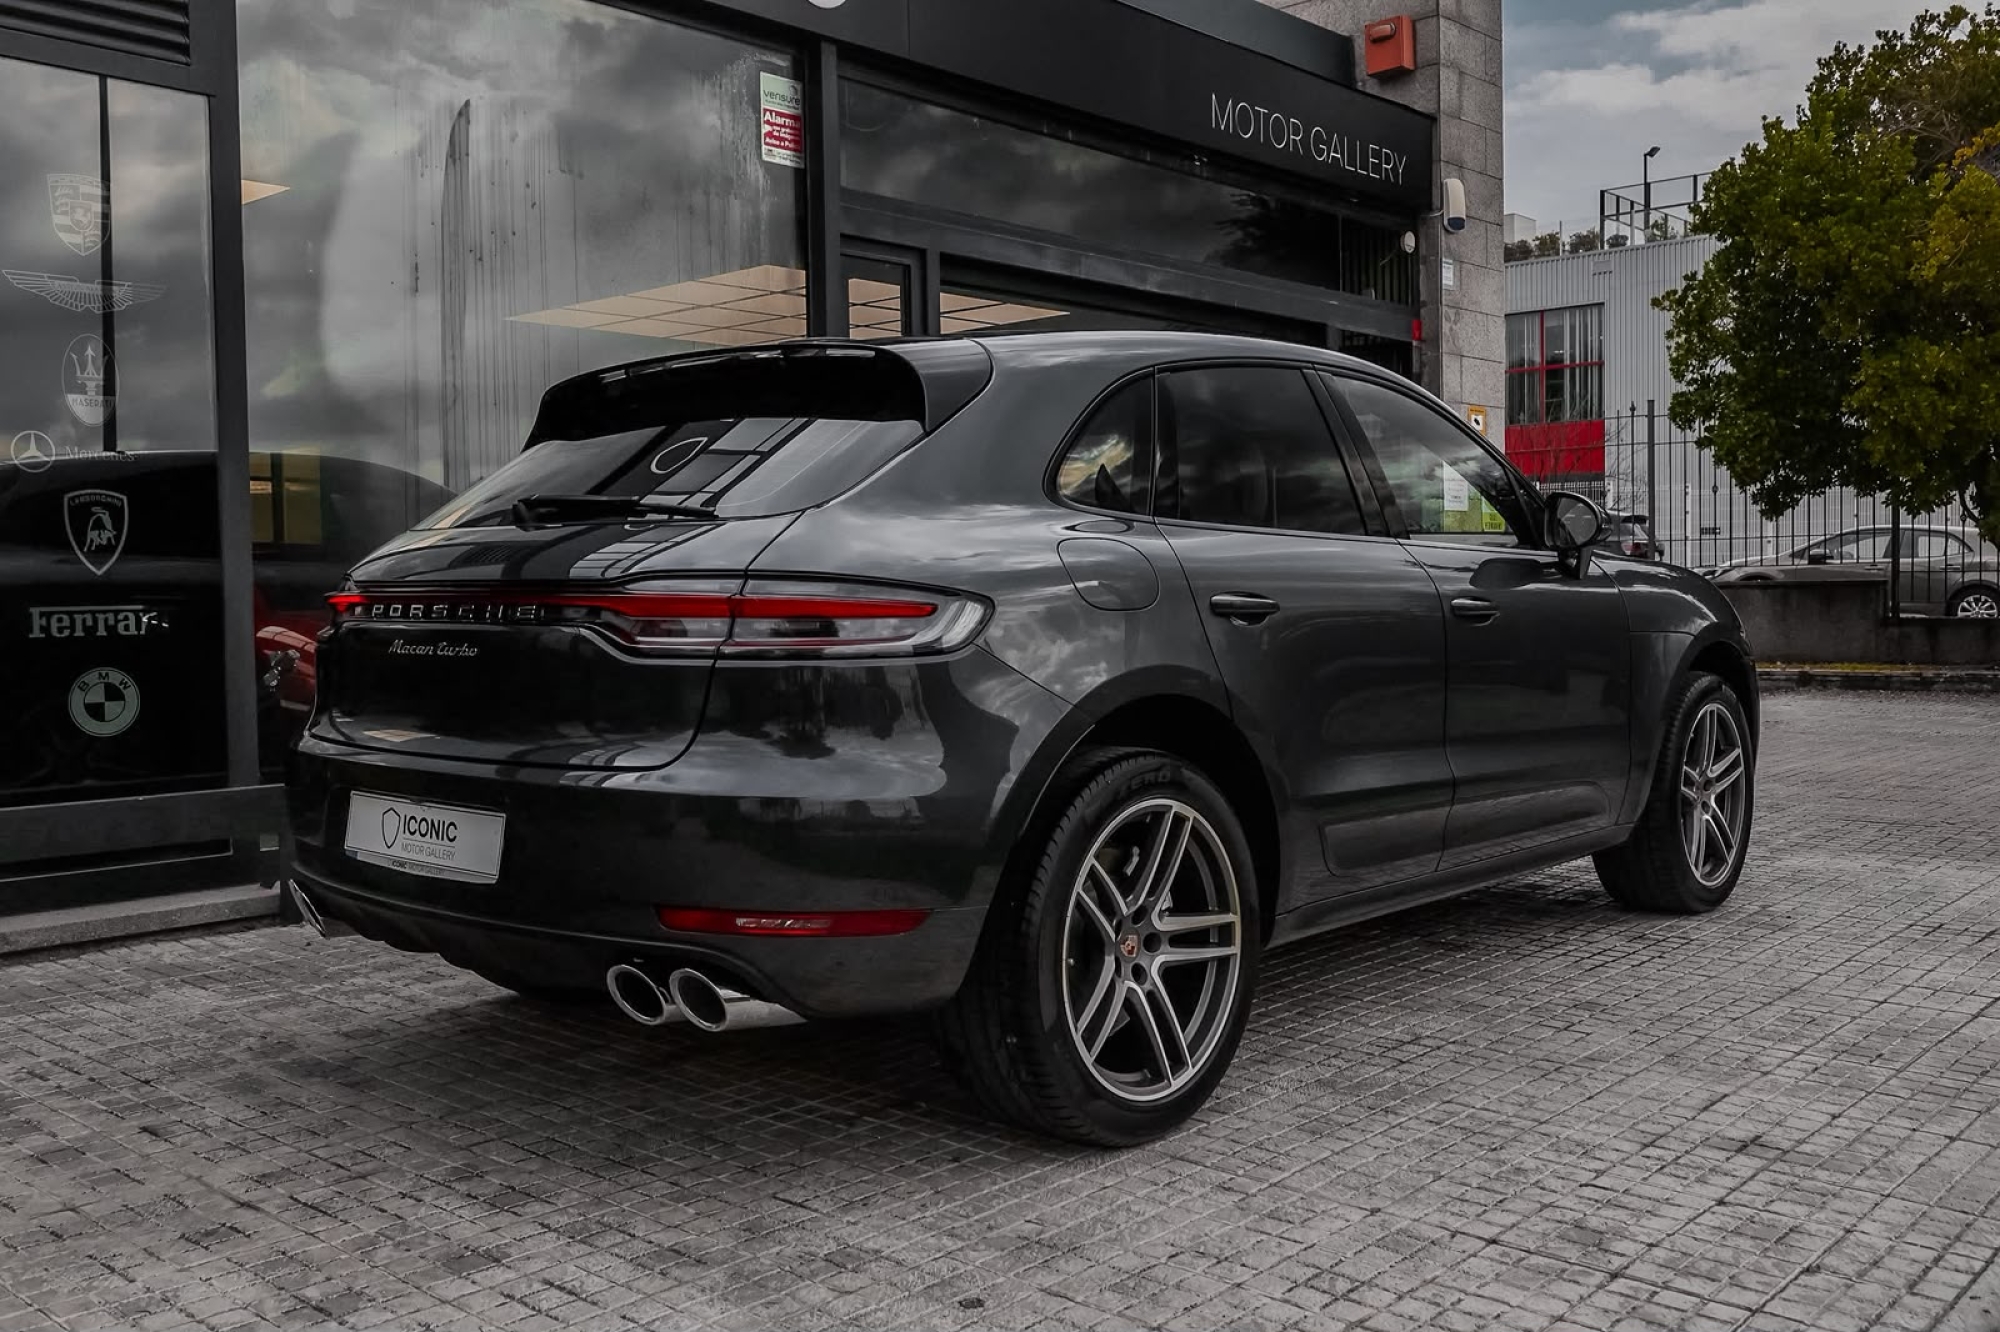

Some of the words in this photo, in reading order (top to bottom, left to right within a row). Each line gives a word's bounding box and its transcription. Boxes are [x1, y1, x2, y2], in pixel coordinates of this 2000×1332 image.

[1211, 93, 1303, 155] MOTOR
[1310, 126, 1406, 185] GALLERY
[371, 604, 536, 619] PORSCHE
[388, 639, 434, 656] Macan
[78, 672, 132, 692] BMW
[403, 814, 458, 843] ICONIC
[402, 843, 425, 855] MOTOR
[425, 847, 456, 860] GALLERY
